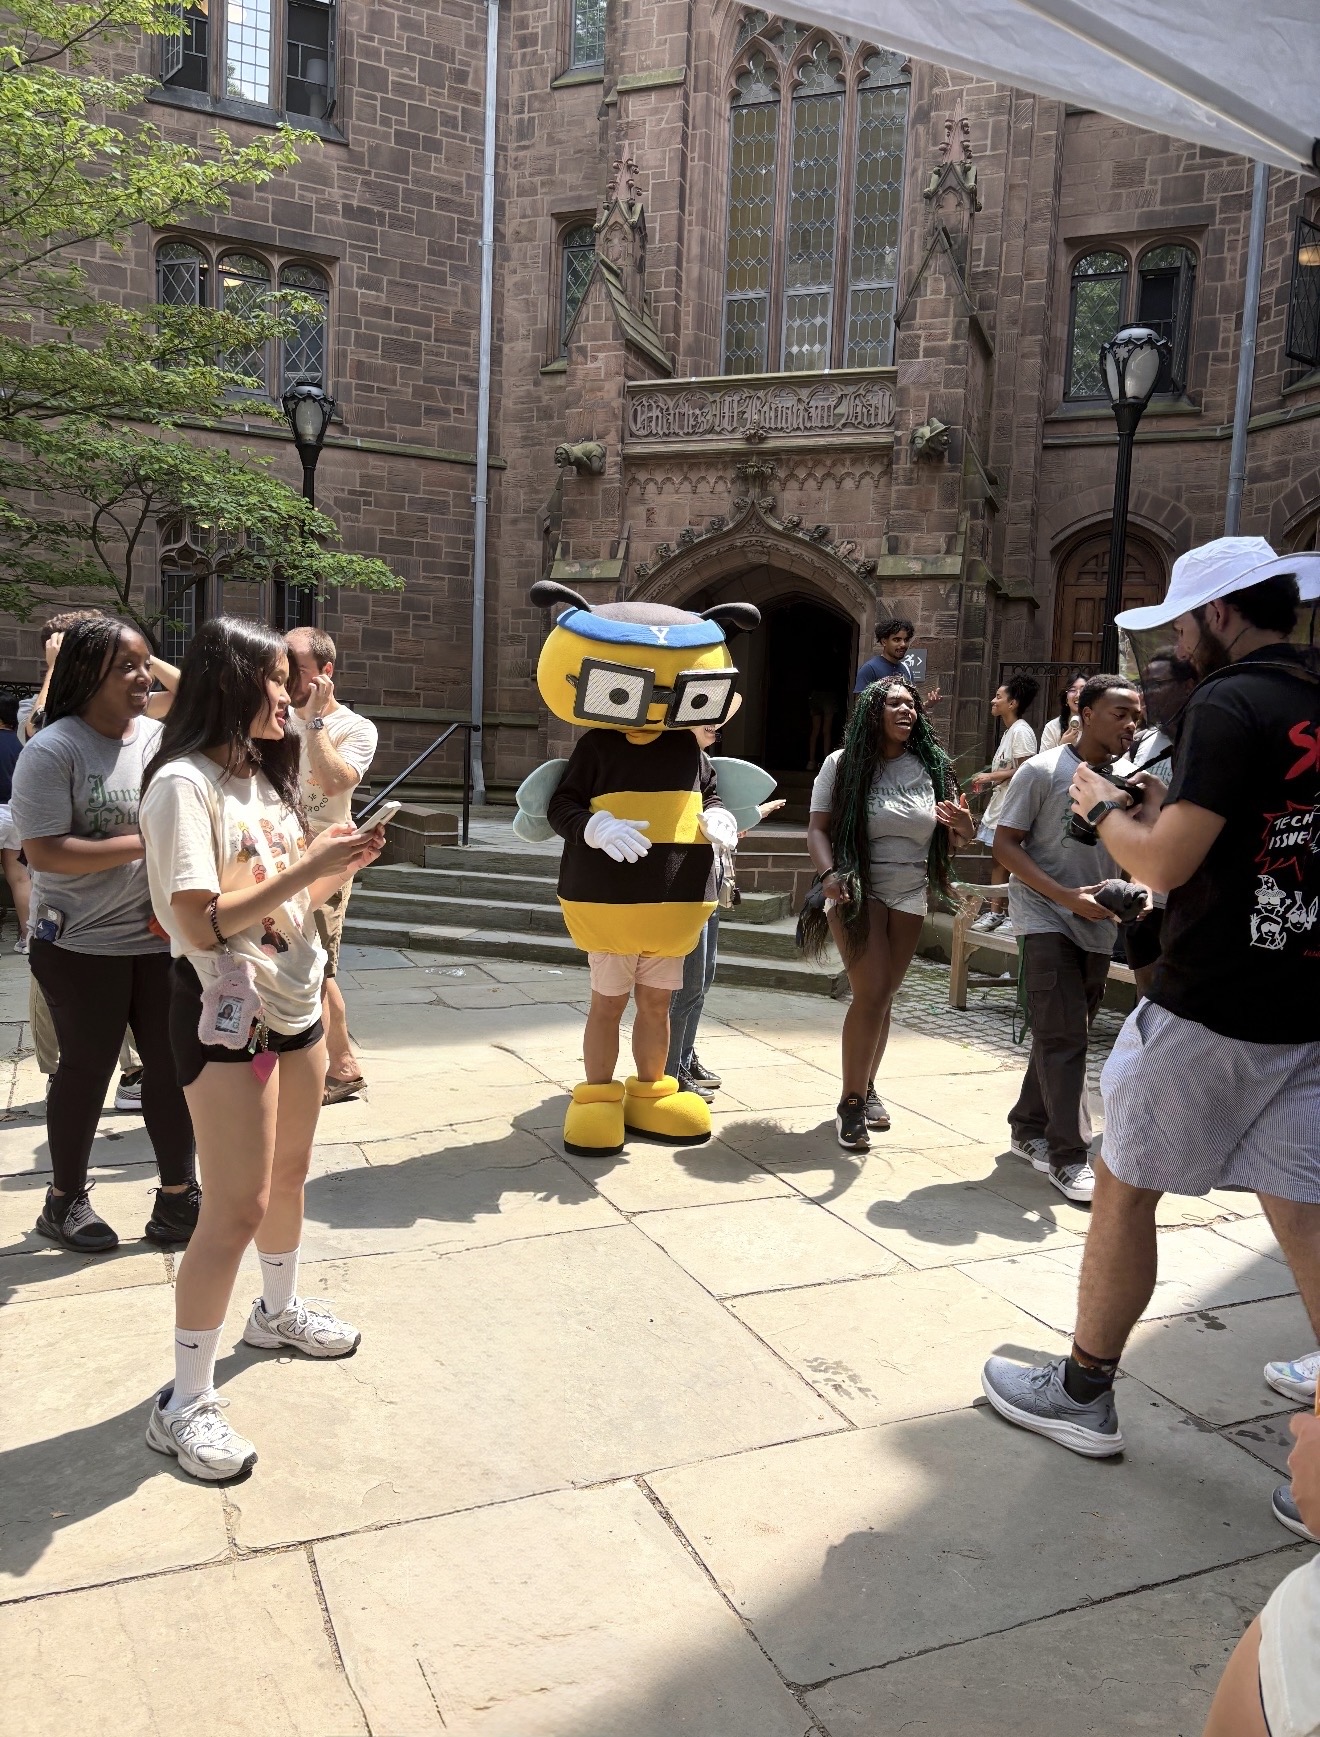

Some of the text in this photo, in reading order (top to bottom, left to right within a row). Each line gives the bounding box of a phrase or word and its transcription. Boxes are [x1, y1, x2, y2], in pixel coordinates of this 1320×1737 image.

[629, 396, 713, 438] Charles
[650, 625, 670, 645] Y
[87, 774, 141, 808] Jona
[868, 784, 931, 797] onathan
[1273, 811, 1314, 831] TECH
